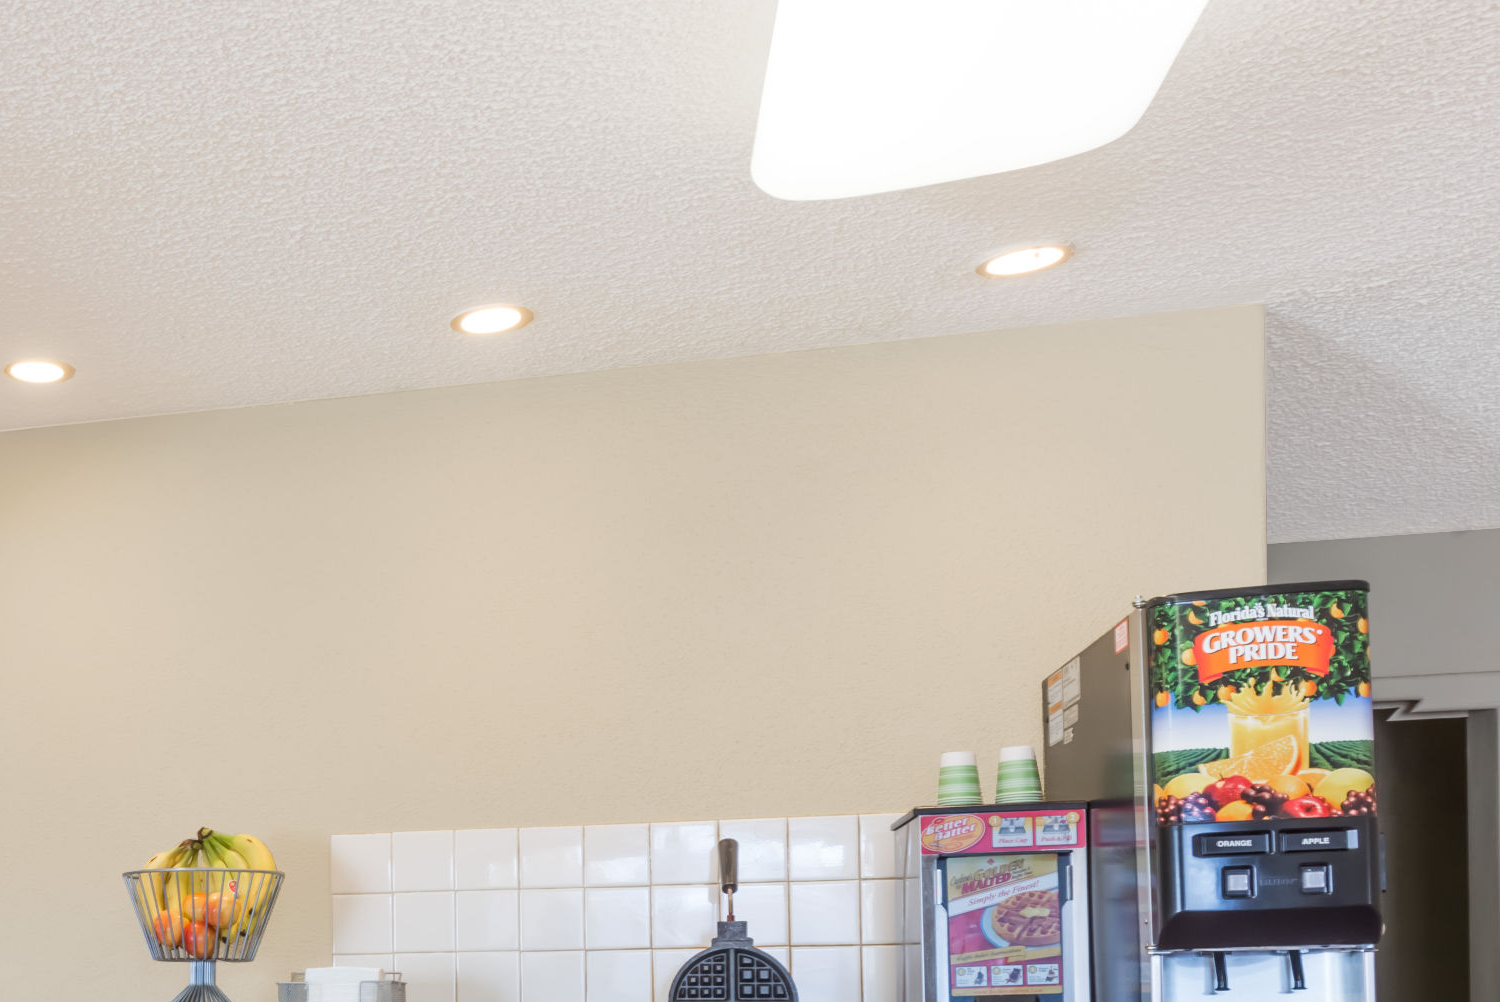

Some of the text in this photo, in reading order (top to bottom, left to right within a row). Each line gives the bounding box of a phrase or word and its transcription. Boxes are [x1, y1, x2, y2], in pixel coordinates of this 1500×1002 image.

[1208, 602, 1315, 626] Florida's Natural
[1229, 643, 1298, 664] PRIDE
[925, 817, 969, 836] Better
[934, 823, 977, 841] Batter
[1301, 837, 1330, 845] APPLE
[961, 872, 1012, 894] MALTED
